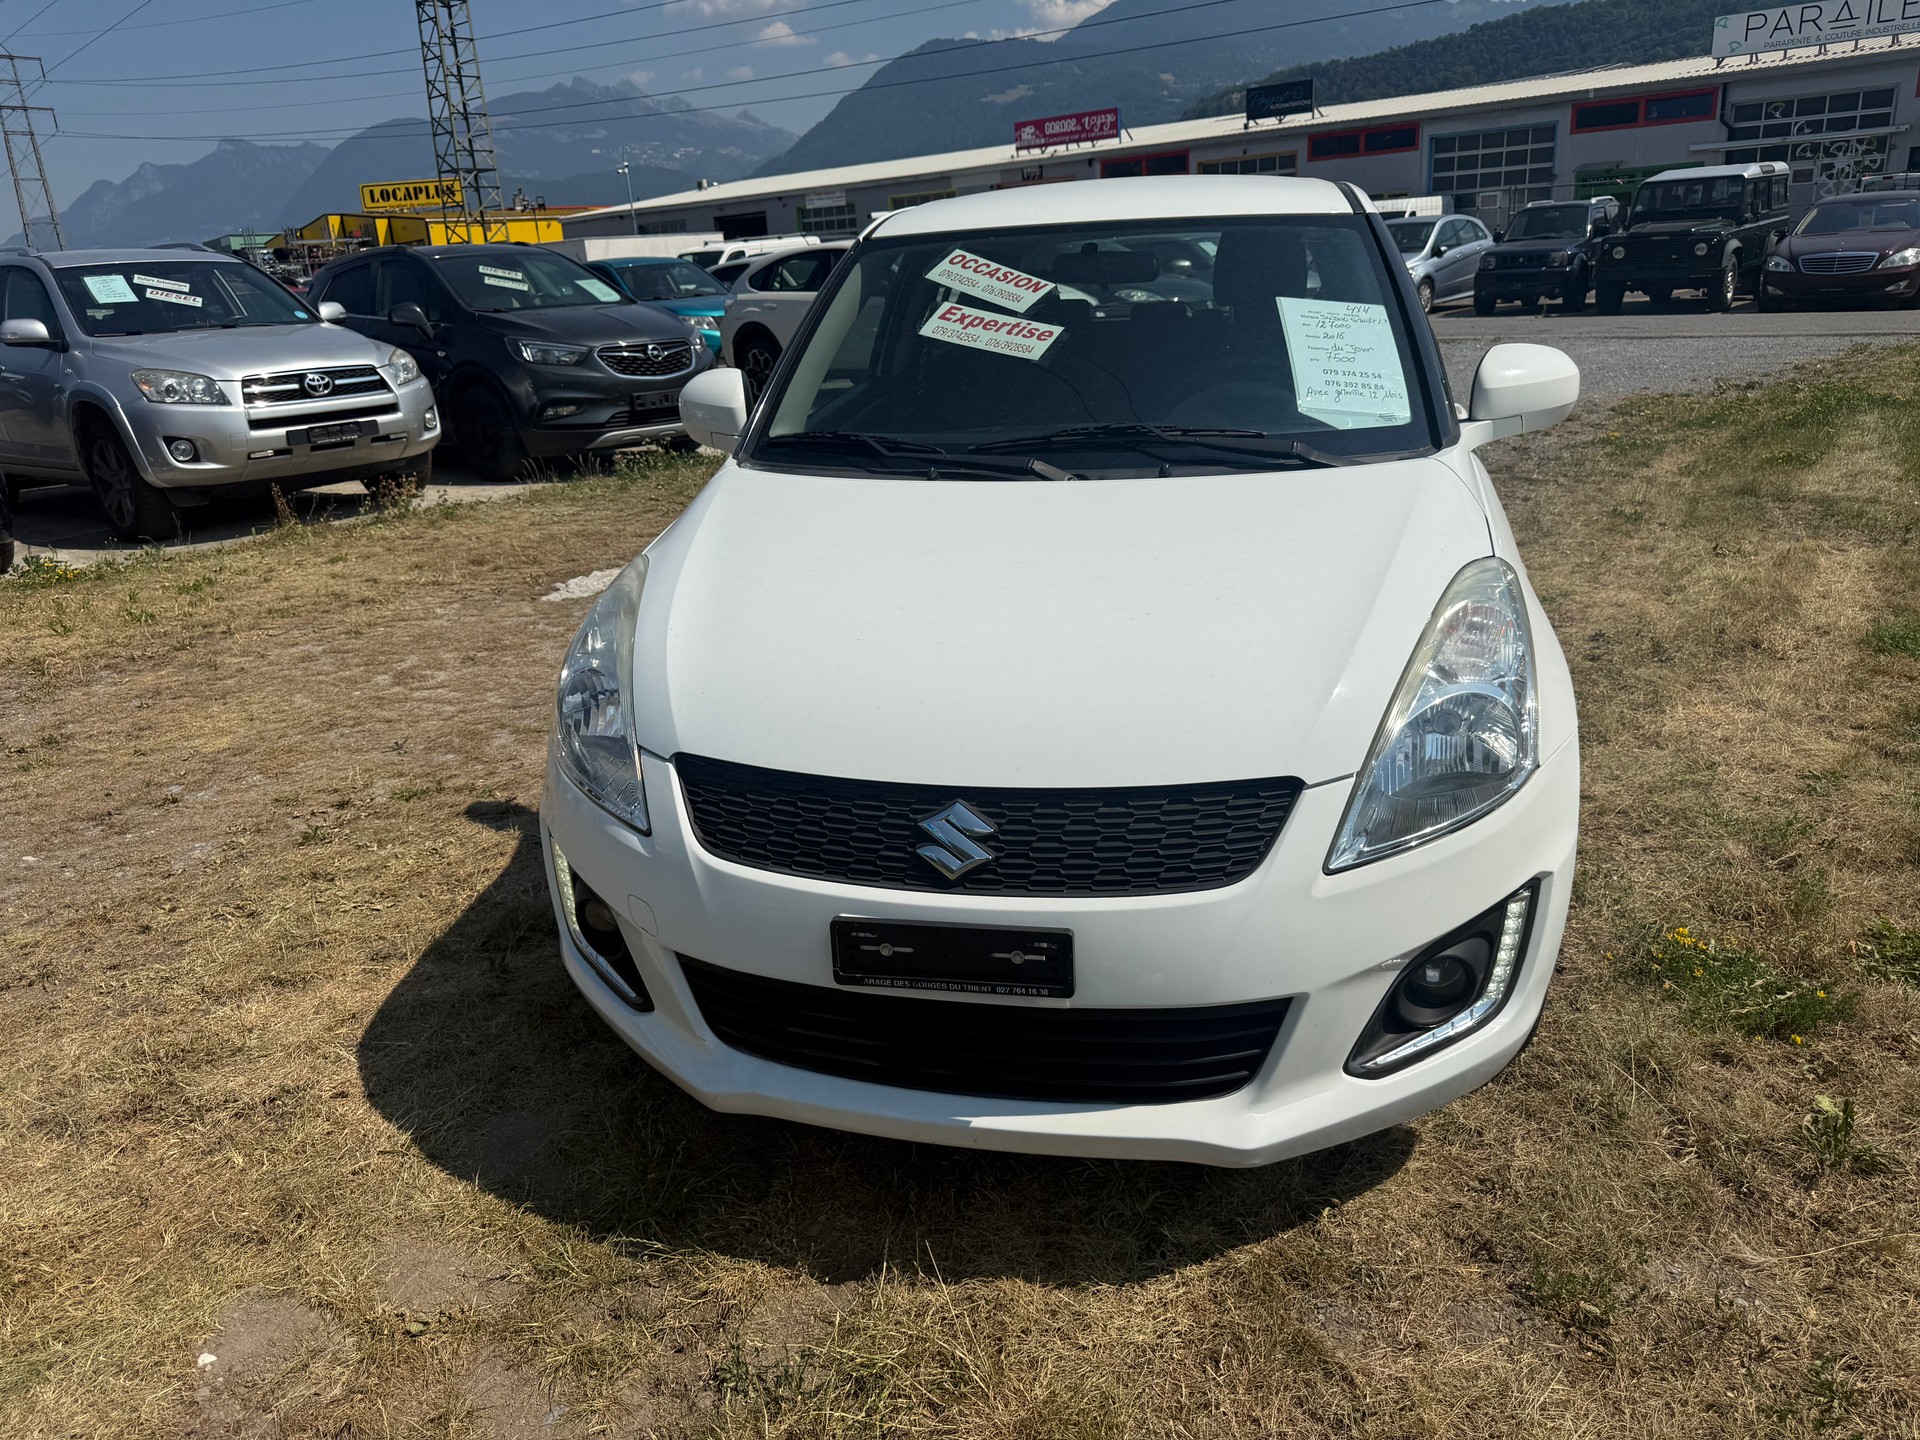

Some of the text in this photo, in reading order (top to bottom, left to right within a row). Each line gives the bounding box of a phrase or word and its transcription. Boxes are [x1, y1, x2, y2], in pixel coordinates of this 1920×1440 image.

[1764, 36, 1811, 48] PARAPENTE
[1825, 29, 1862, 41] COUTURE
[1270, 99, 1311, 110] AUTOMATISATIONS
[1044, 118, 1077, 135] GARAGE
[369, 183, 456, 203] LOCAPLUS
[481, 266, 520, 277] DIESEL
[948, 254, 1049, 293] OCCASION
[156, 279, 187, 288] Automatique
[938, 269, 978, 288] 079/3742554
[981, 284, 1024, 303] 076/3928584
[149, 290, 200, 303] DIESEL
[938, 305, 1054, 342] Expertise
[931, 325, 978, 343] 079/3742554
[985, 338, 1035, 354] 076/3928584
[1322, 331, 1345, 340] 2016
[1331, 343, 1344, 352] du
[1325, 351, 1356, 363] 7500
[1322, 368, 1339, 376] 079
[1324, 379, 1341, 387] 076
[1306, 386, 1329, 397] Avec
[1369, 391, 1378, 399] 12
[893, 979, 910, 987] DES
[912, 981, 948, 990] GORGES
[949, 983, 961, 991] DU
[963, 984, 991, 992] TRIENT
[996, 986, 1010, 994] 027
[1012, 986, 1026, 994] 764
[1029, 987, 1037, 995] 16
